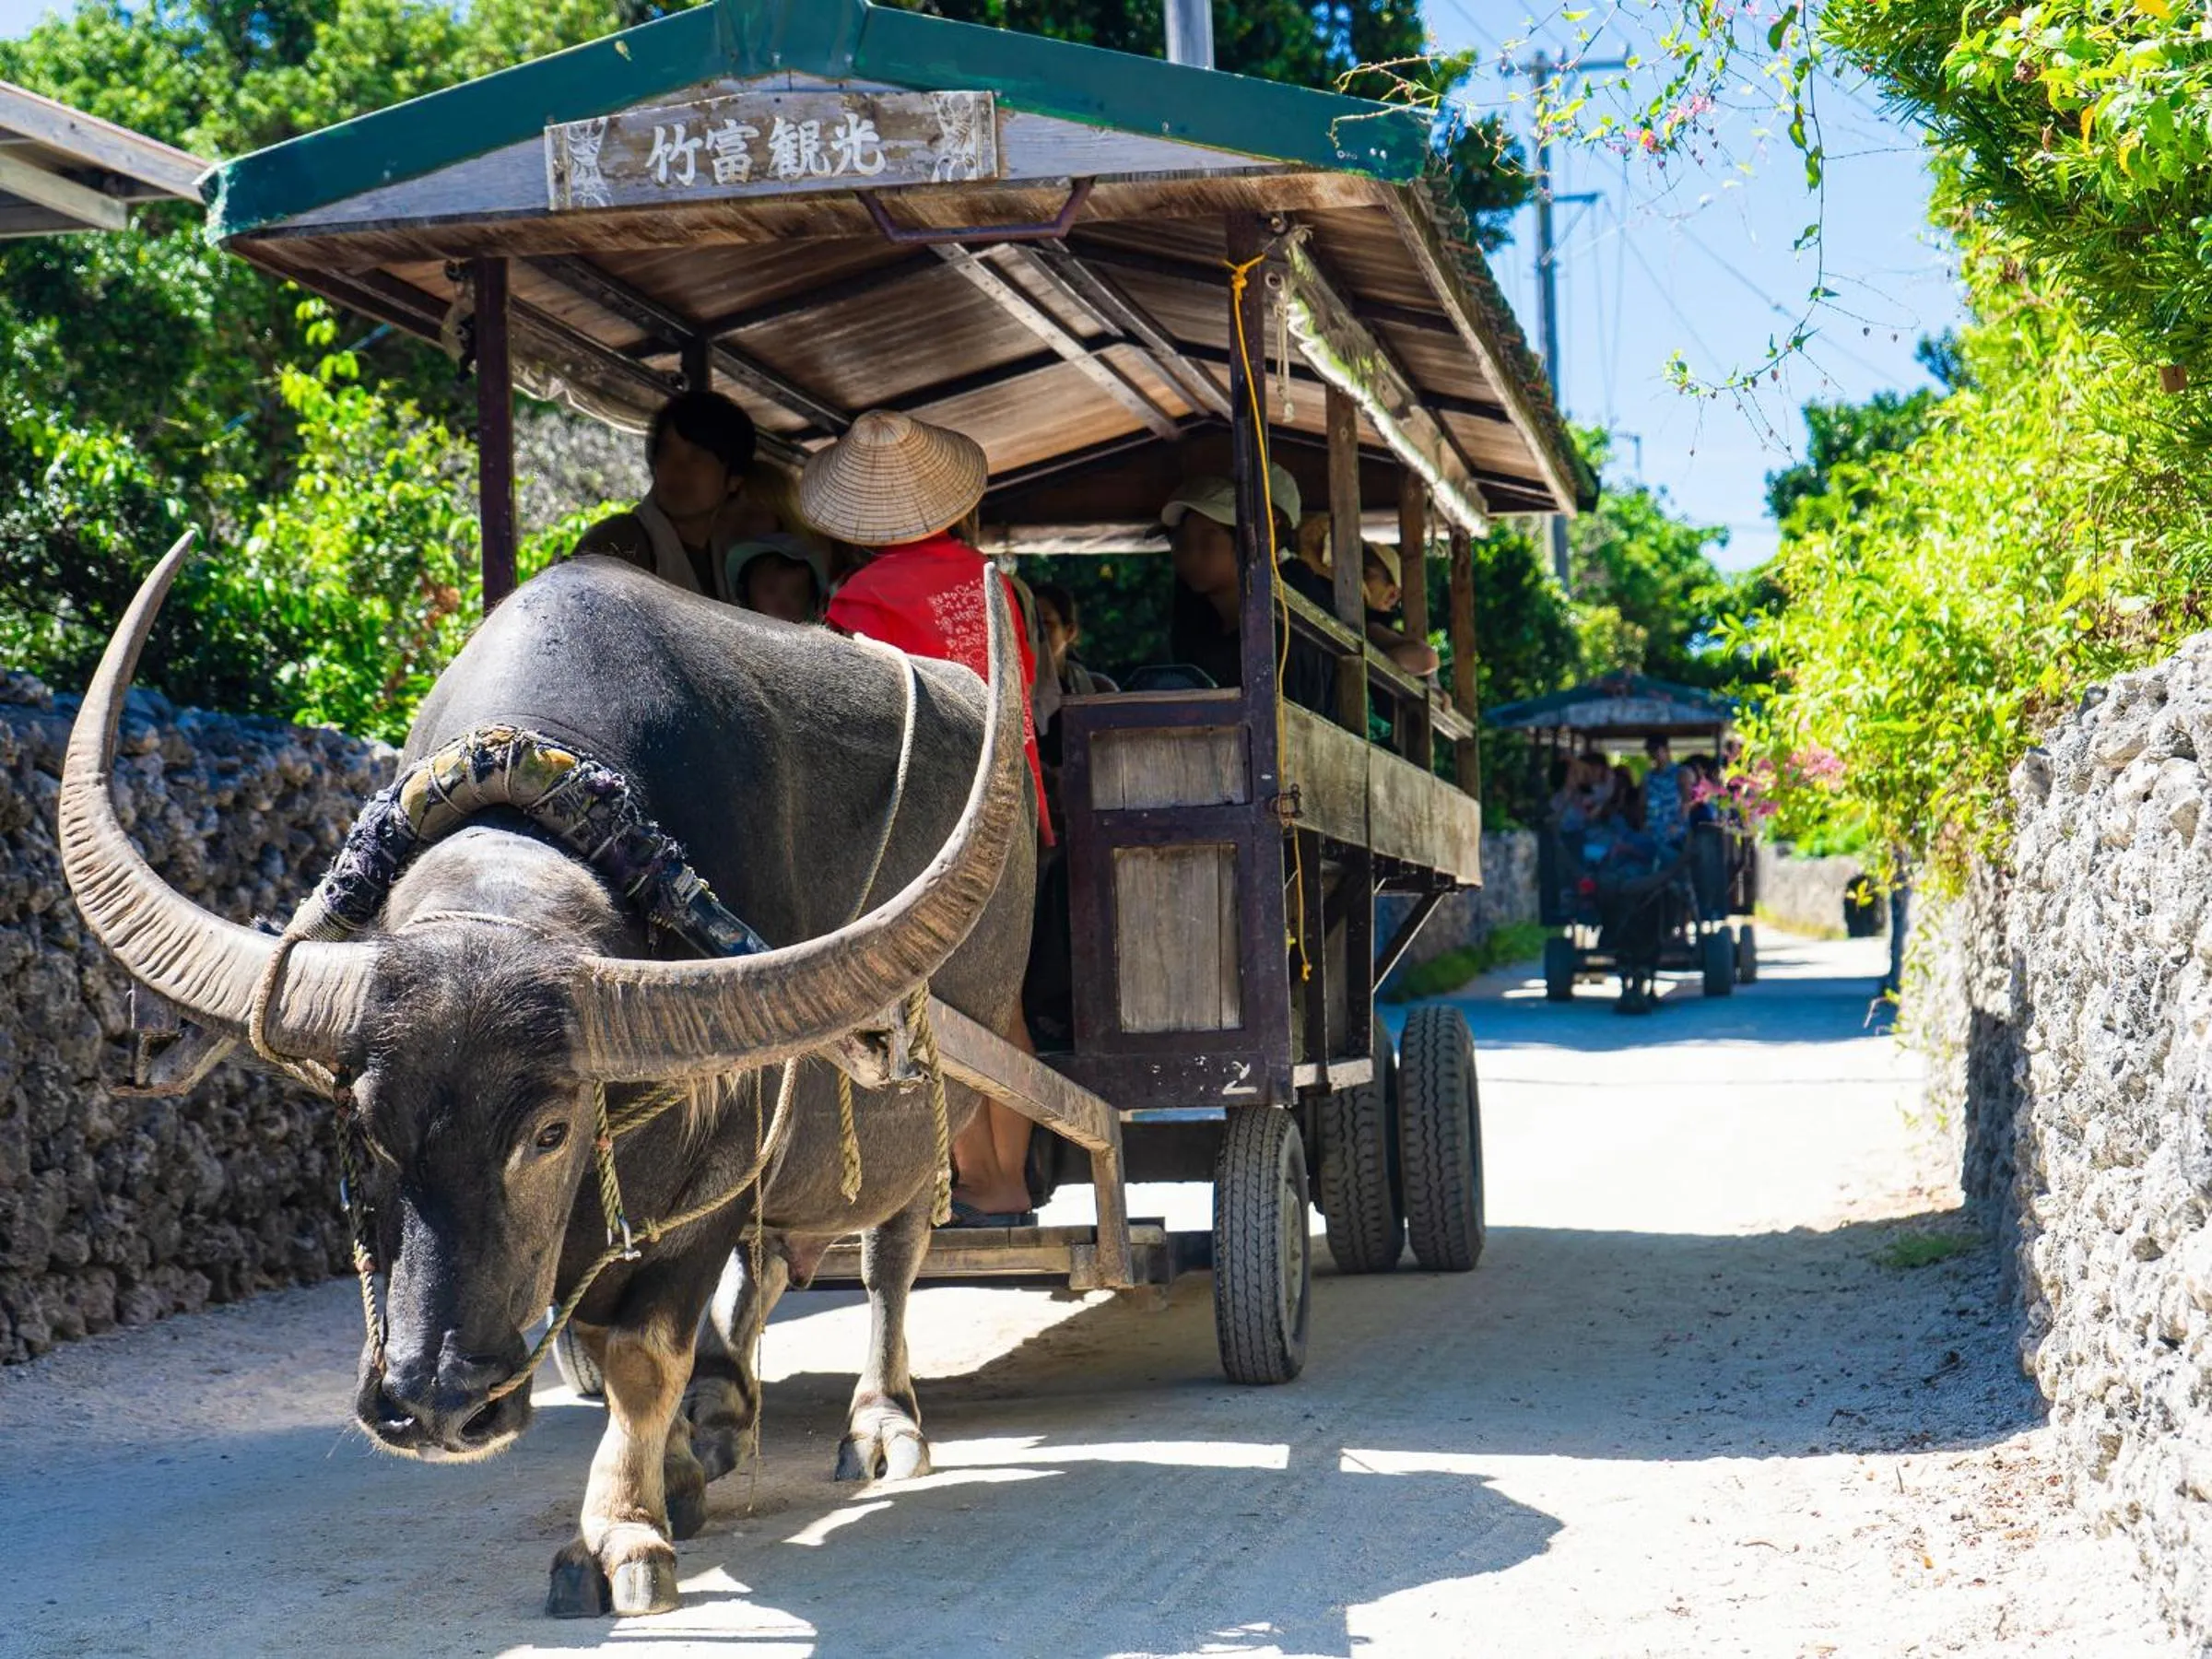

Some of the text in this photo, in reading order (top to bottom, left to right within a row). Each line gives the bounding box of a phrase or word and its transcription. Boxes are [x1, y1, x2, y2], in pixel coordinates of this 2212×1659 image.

[645, 114, 887, 186] 竹富観光
[1222, 1061, 1257, 1095] 2
